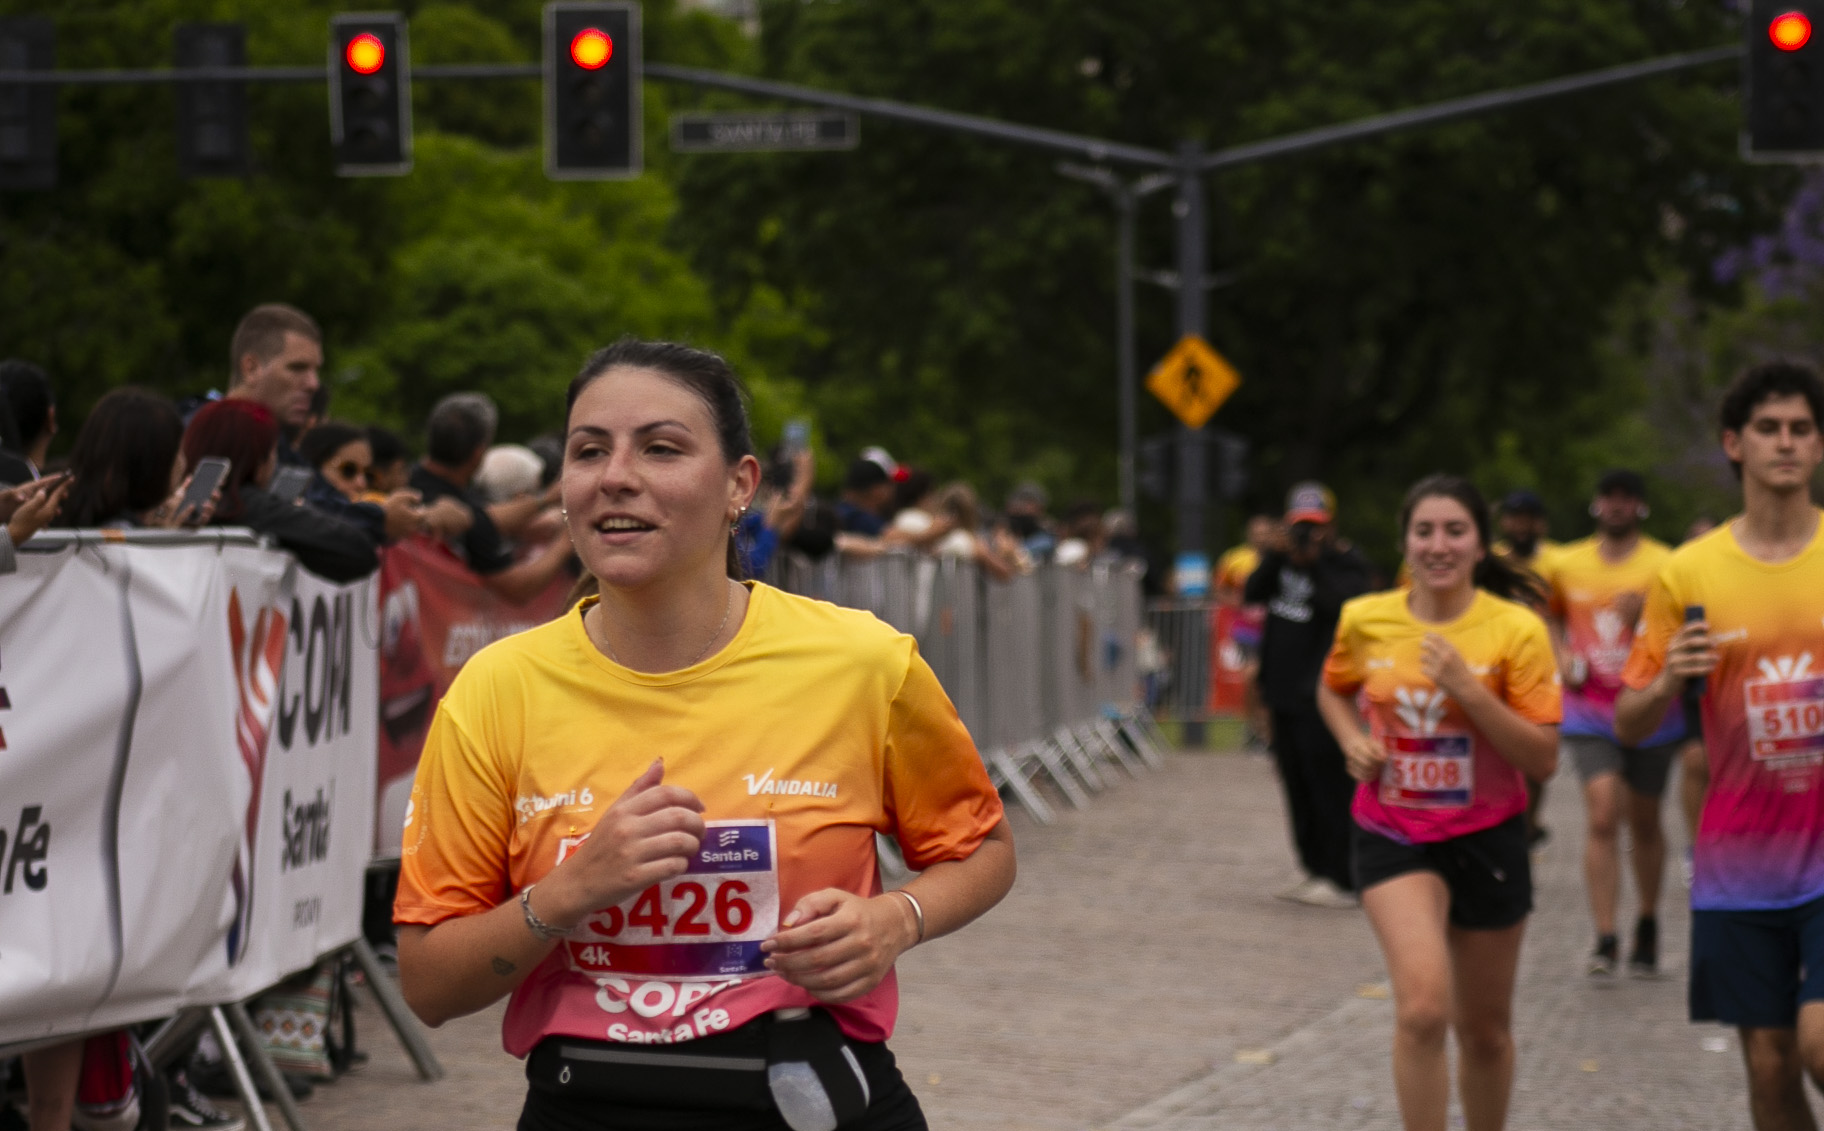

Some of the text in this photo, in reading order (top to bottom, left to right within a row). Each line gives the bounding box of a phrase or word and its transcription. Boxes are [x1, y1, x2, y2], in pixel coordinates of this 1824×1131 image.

[742, 767, 838, 799] VANDALIA
[580, 787, 594, 806] 6
[701, 849, 760, 864] Santa Fe
[579, 946, 611, 967] 4k
[595, 977, 742, 1018] COP
[693, 1007, 731, 1036] Fe
